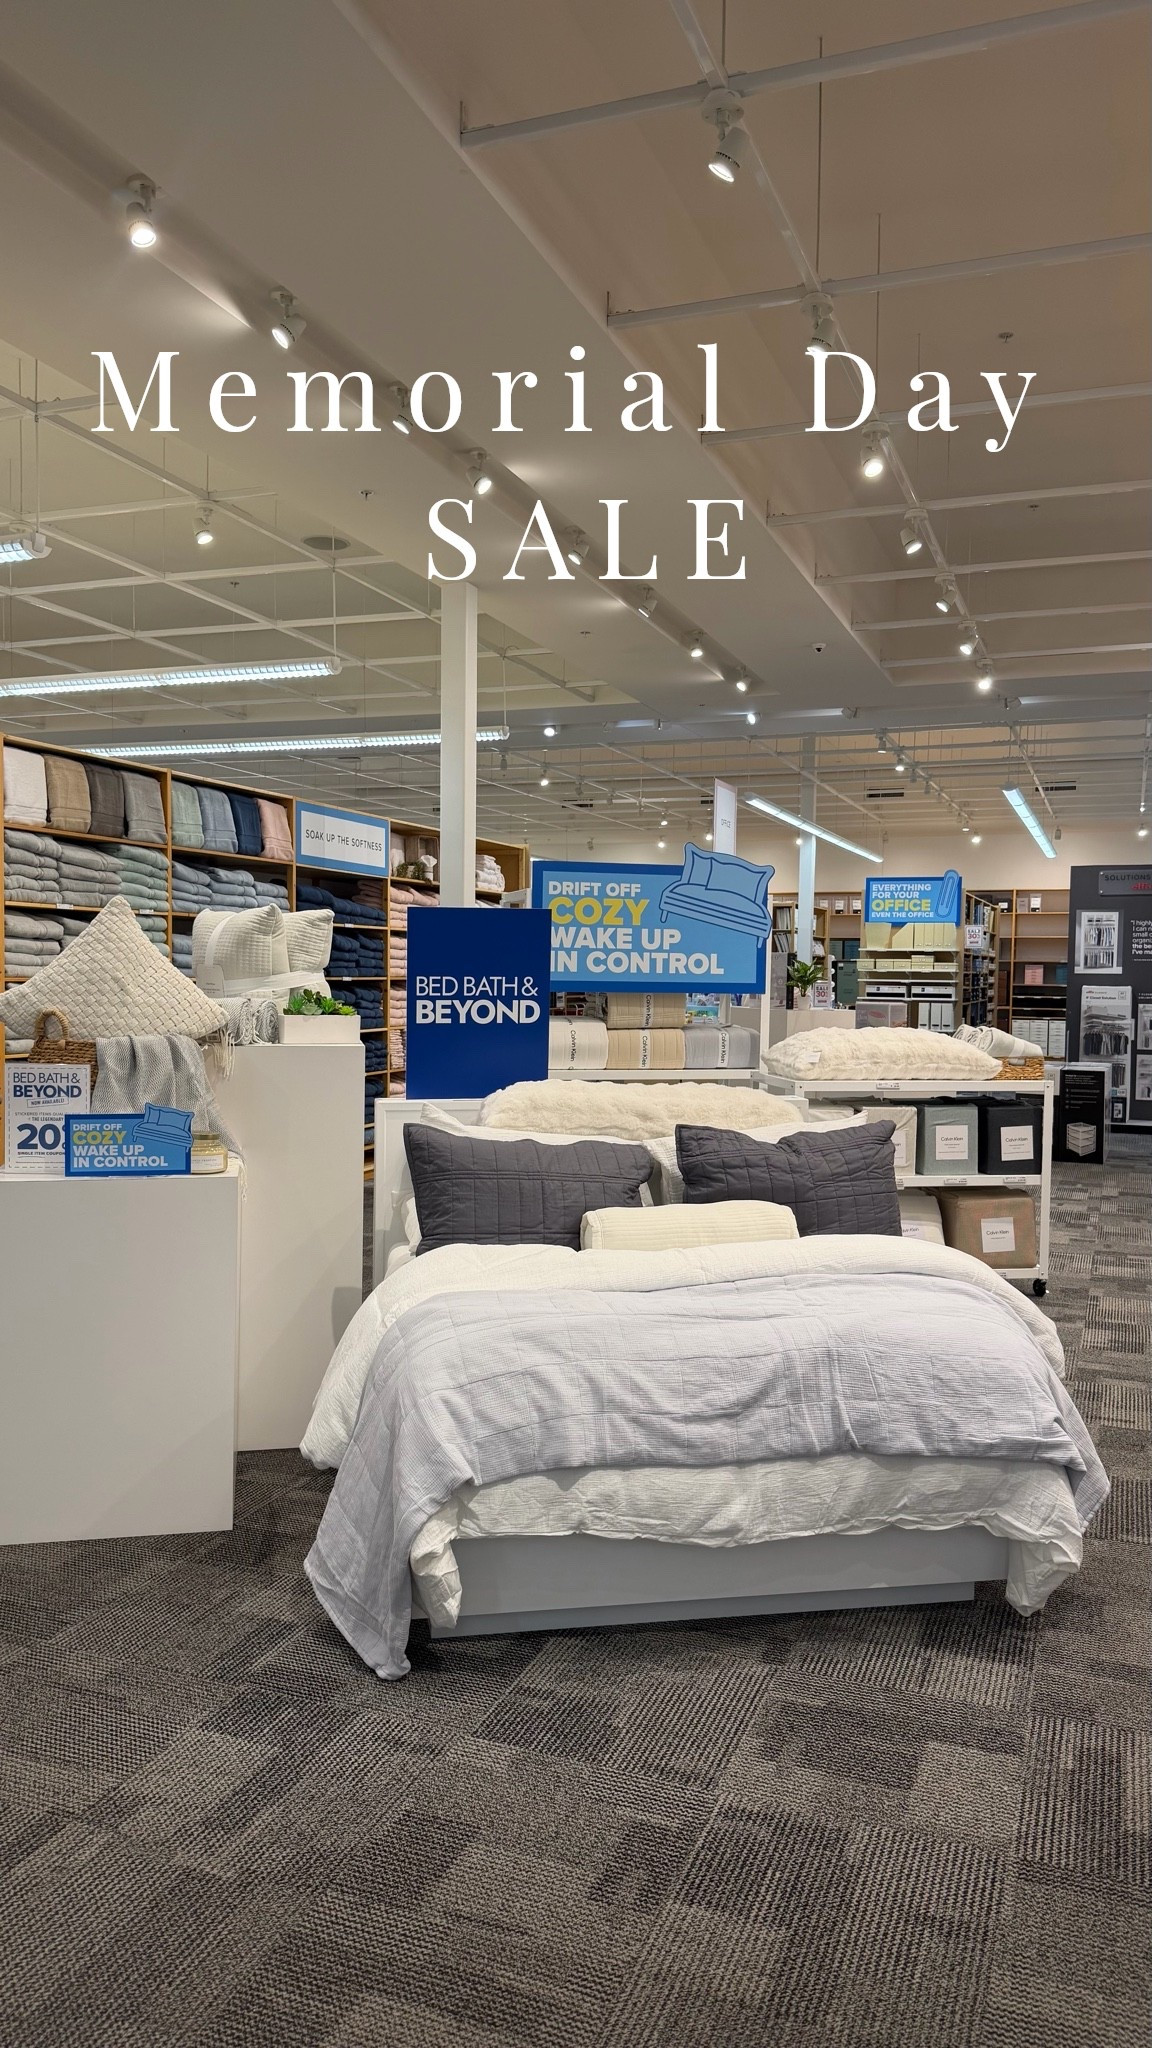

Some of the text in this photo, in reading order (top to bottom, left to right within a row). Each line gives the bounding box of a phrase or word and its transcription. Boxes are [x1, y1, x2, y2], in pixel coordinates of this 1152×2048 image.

[305, 829, 382, 852] SOAK UP THE SOFTNESS
[548, 881, 641, 897] DRIFT OFF
[872, 883, 932, 891] EVERYTHING
[872, 891, 920, 899] FOR YOUR
[548, 896, 650, 926] COZY
[871, 899, 931, 911] OFFICE
[551, 926, 682, 950] WAKE UP
[550, 950, 725, 975] IN CONTROL
[416, 976, 538, 996] BED BATH &
[416, 999, 541, 1025] BEYOND
[13, 1072, 37, 1083] BED
[39, 1072, 69, 1083] BATH
[13, 1085, 82, 1098] BEYOND
[103, 1123, 122, 1131] OFF
[72, 1131, 127, 1145] COZY
[73, 1144, 144, 1156] WAKE UP
[73, 1156, 168, 1168] IN CONTROL
